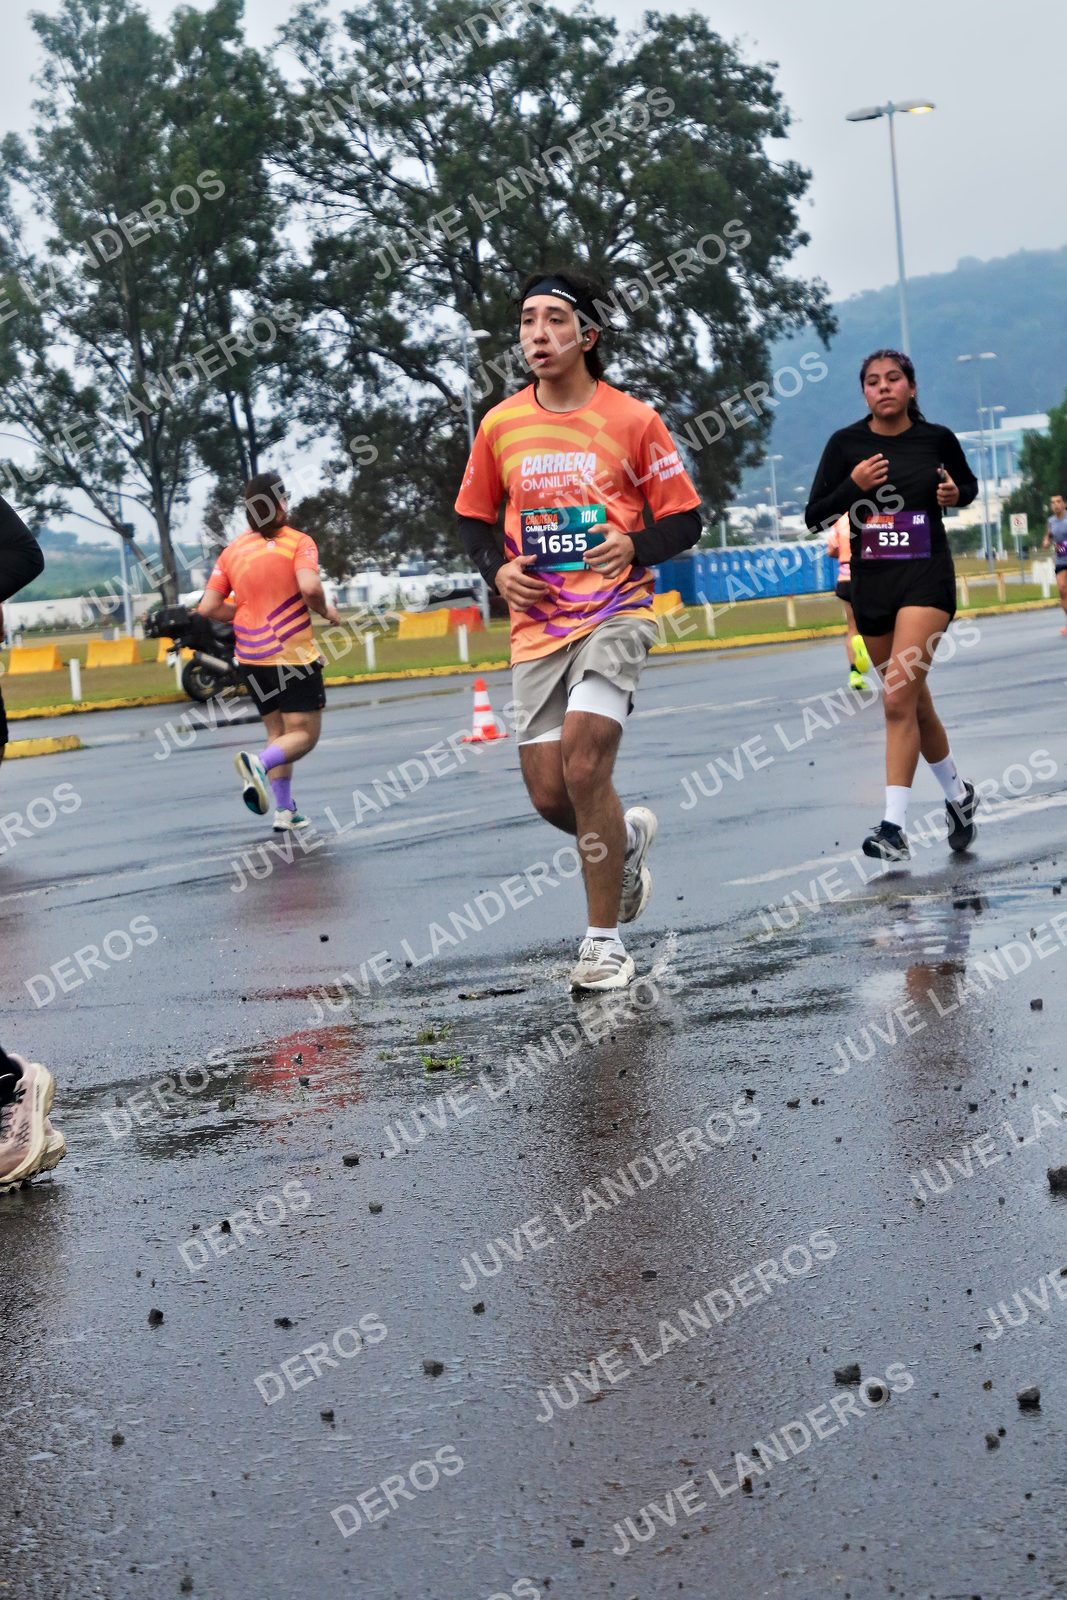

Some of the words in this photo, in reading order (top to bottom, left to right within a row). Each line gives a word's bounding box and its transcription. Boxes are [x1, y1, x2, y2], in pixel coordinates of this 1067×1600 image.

[521, 452, 597, 477] CARRERA
[521, 474, 580, 492] OMNILIFE
[525, 514, 558, 526] CARRERA
[581, 510, 598, 524] 10K
[913, 514, 925, 525] 15K
[537, 533, 588, 554] 1655
[878, 532, 910, 546] 532
